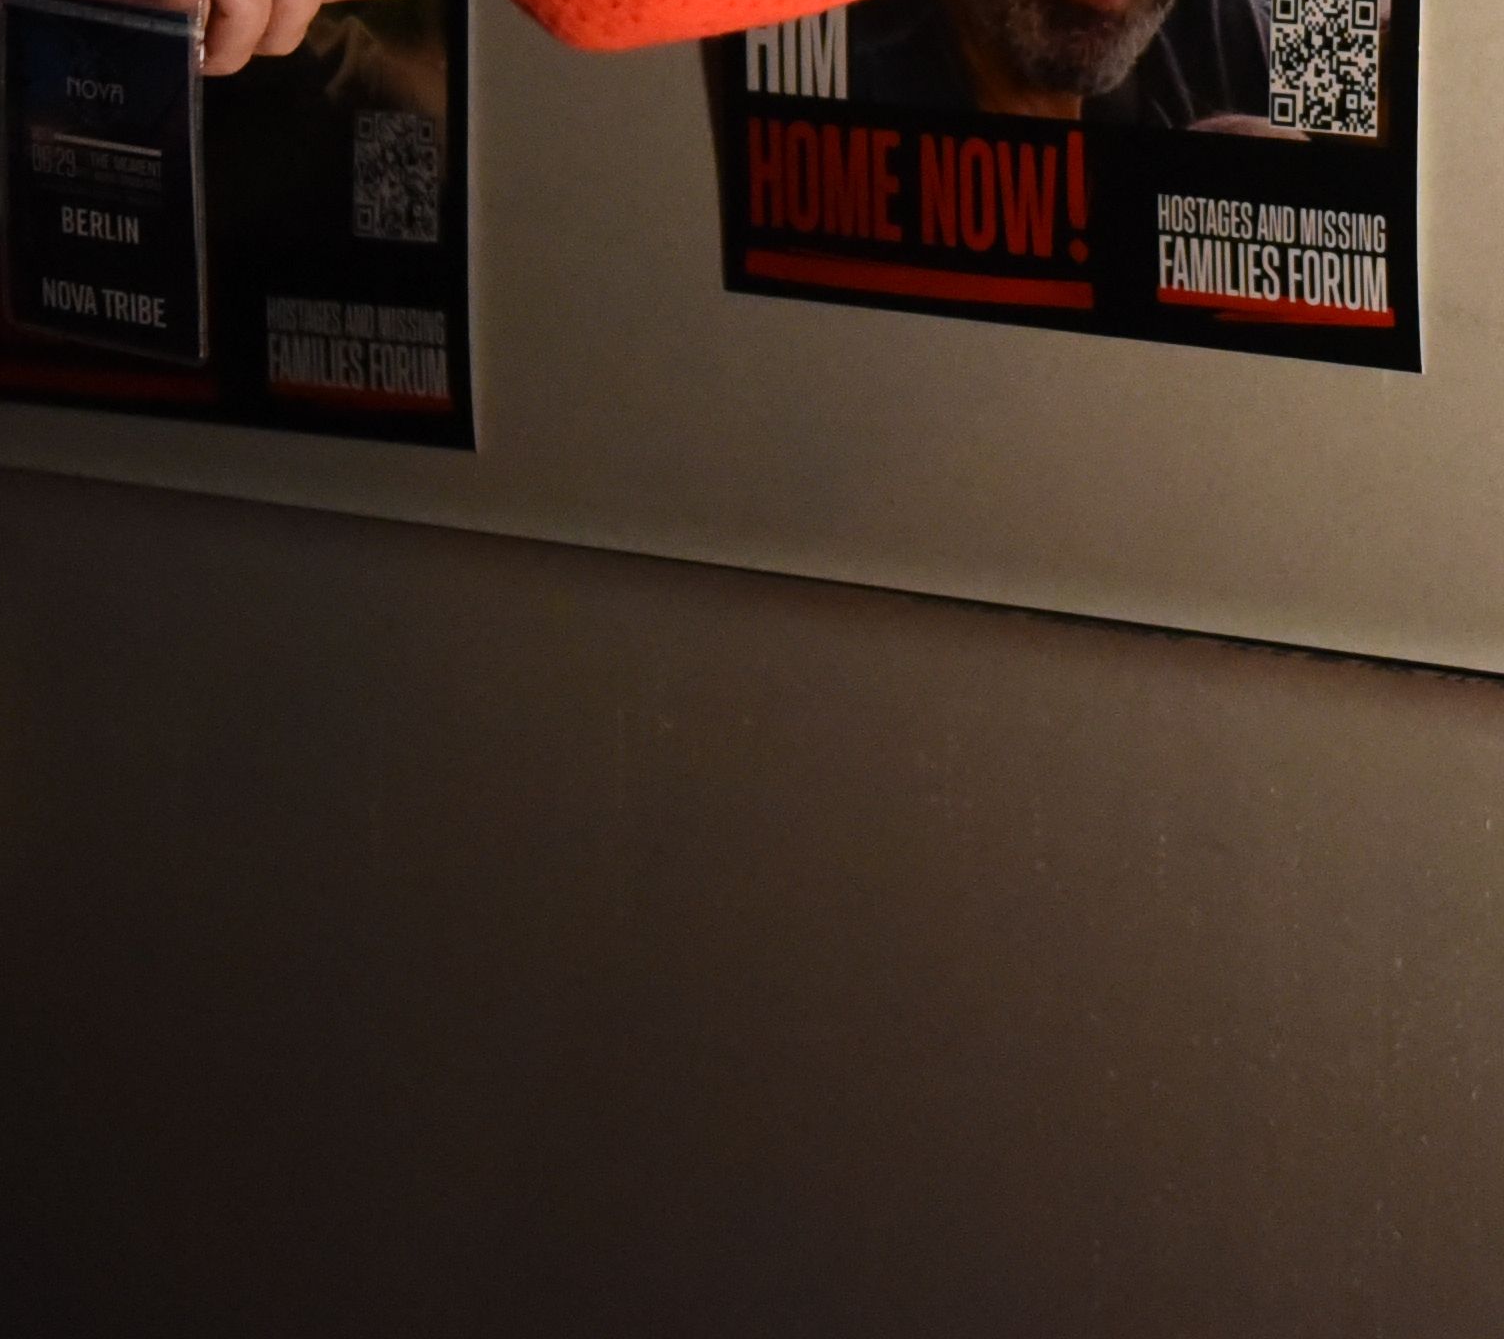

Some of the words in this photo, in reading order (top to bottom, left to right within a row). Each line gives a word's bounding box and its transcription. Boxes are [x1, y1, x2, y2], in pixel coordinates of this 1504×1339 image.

[748, 116, 903, 245] HOME
[918, 126, 1093, 265] NOW!
[60, 204, 141, 246] BERLIN
[1156, 191, 1256, 242] HOSTAGES
[1257, 201, 1297, 246] AND
[1299, 207, 1387, 256] MISSING
[41, 276, 98, 316] NOVA
[101, 287, 168, 329] TRIBE
[1158, 234, 1282, 303] FAMILIES
[1287, 246, 1389, 313] FORUM
[368, 341, 449, 399] FORUM
